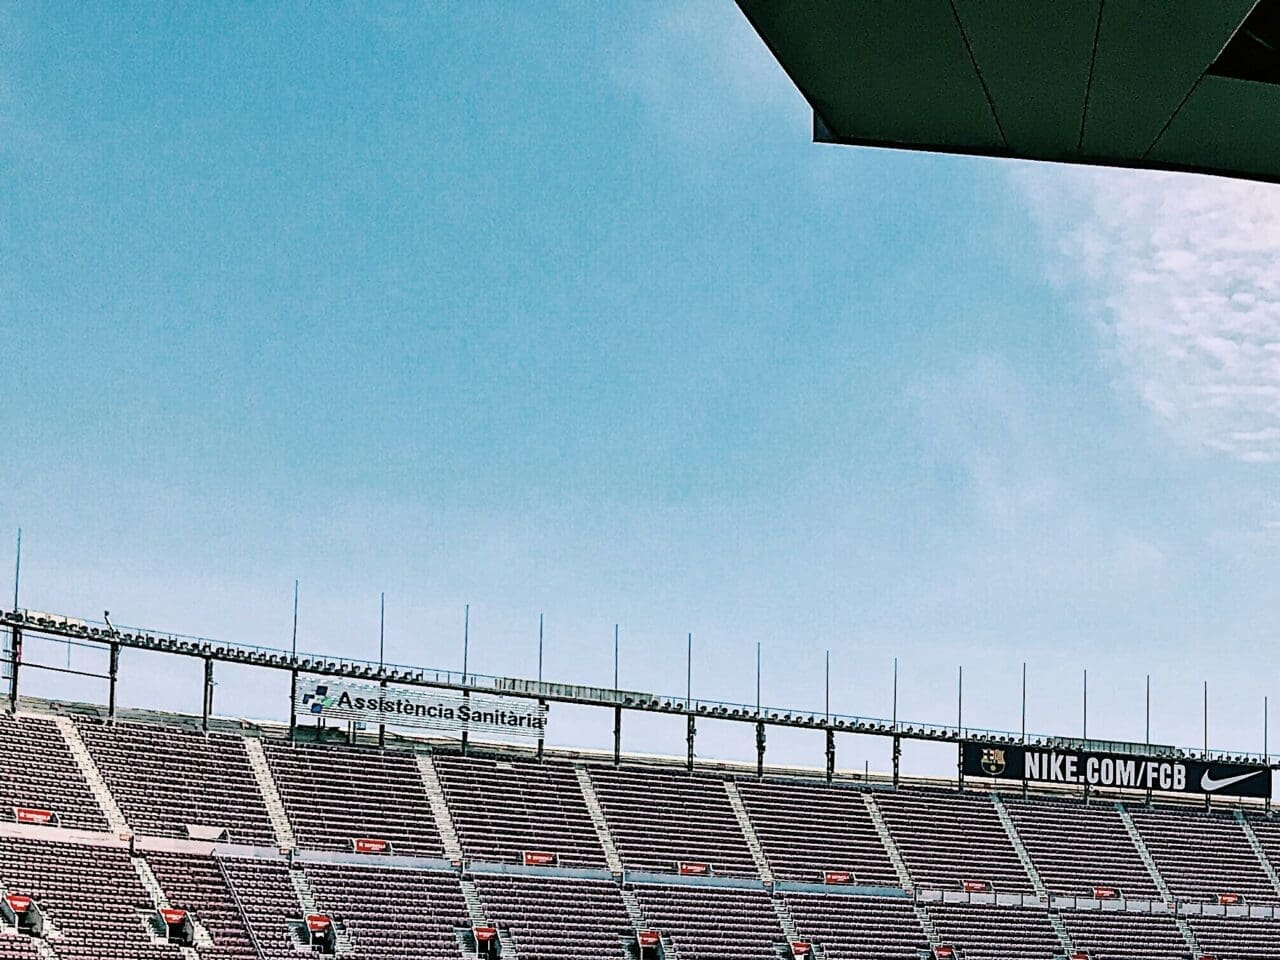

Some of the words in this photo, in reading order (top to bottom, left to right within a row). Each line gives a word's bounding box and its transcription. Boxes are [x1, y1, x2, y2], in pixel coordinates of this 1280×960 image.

[337, 691, 454, 719] Assistència
[457, 705, 544, 729] Sanitària
[1025, 752, 1186, 790] NIKE.COM/FCB
